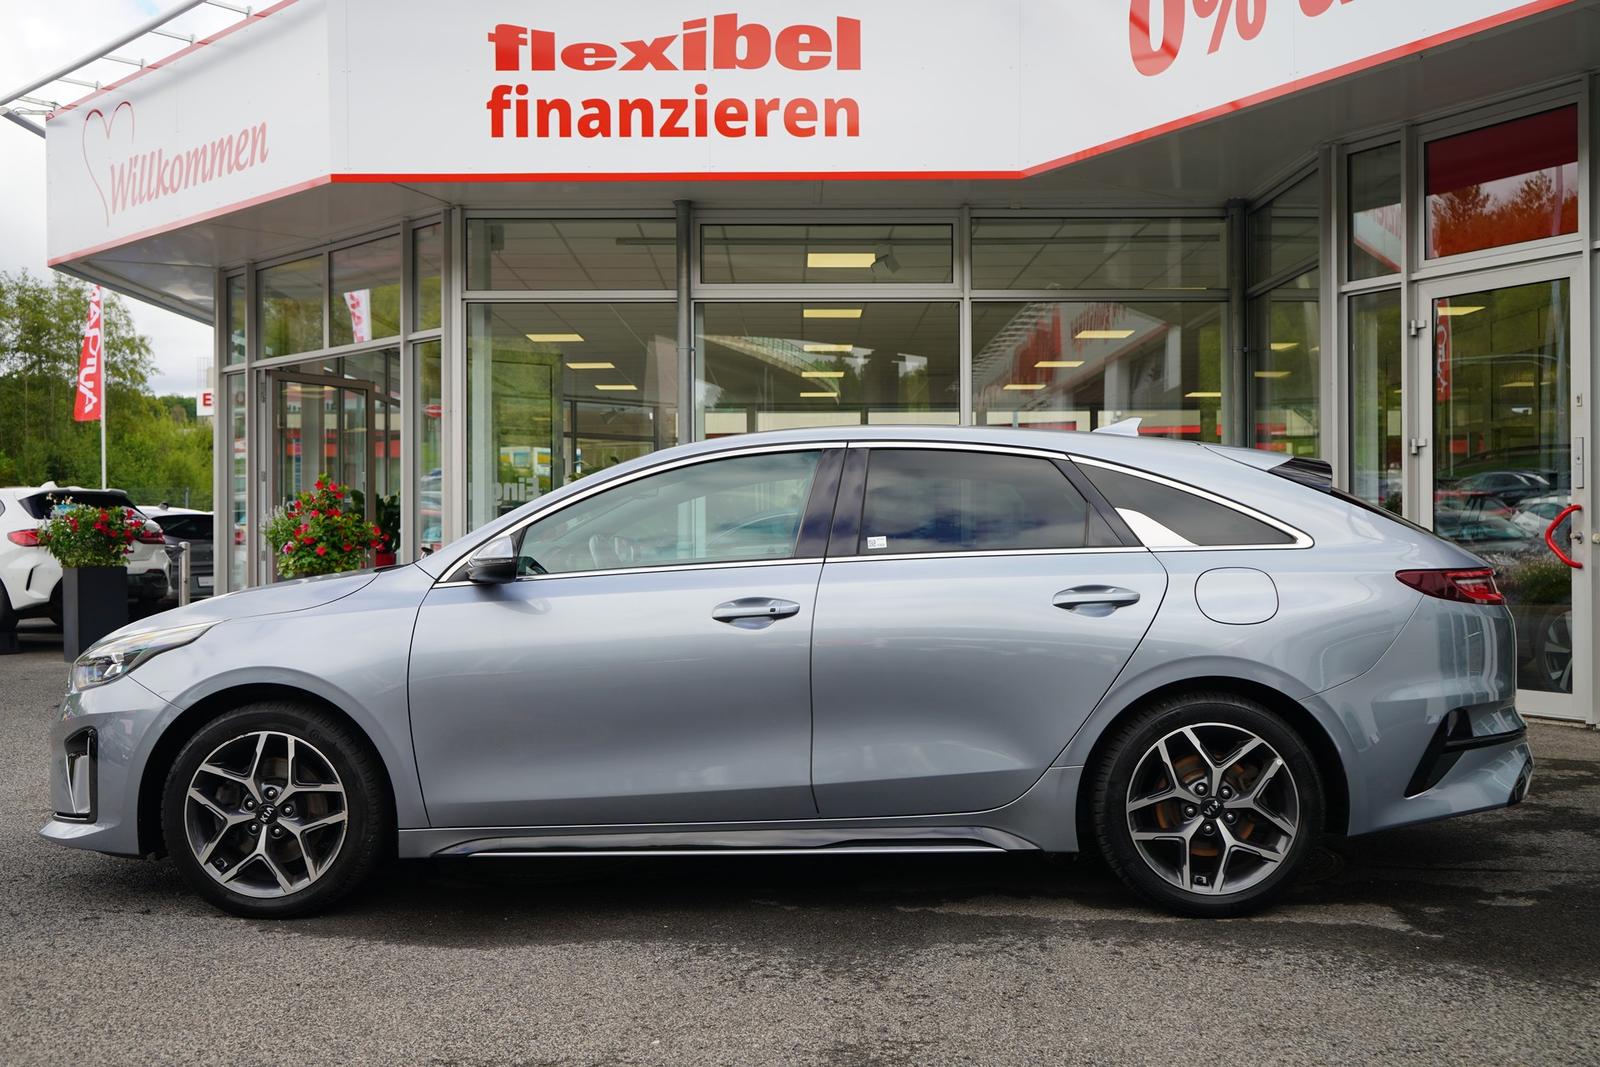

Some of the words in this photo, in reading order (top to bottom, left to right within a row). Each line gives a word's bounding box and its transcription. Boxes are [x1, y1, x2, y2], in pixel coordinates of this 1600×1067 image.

[487, 13, 861, 71] flexibel
[486, 83, 860, 137] finanzieren
[110, 121, 269, 214] Willkommen
[260, 807, 274, 822] KIA
